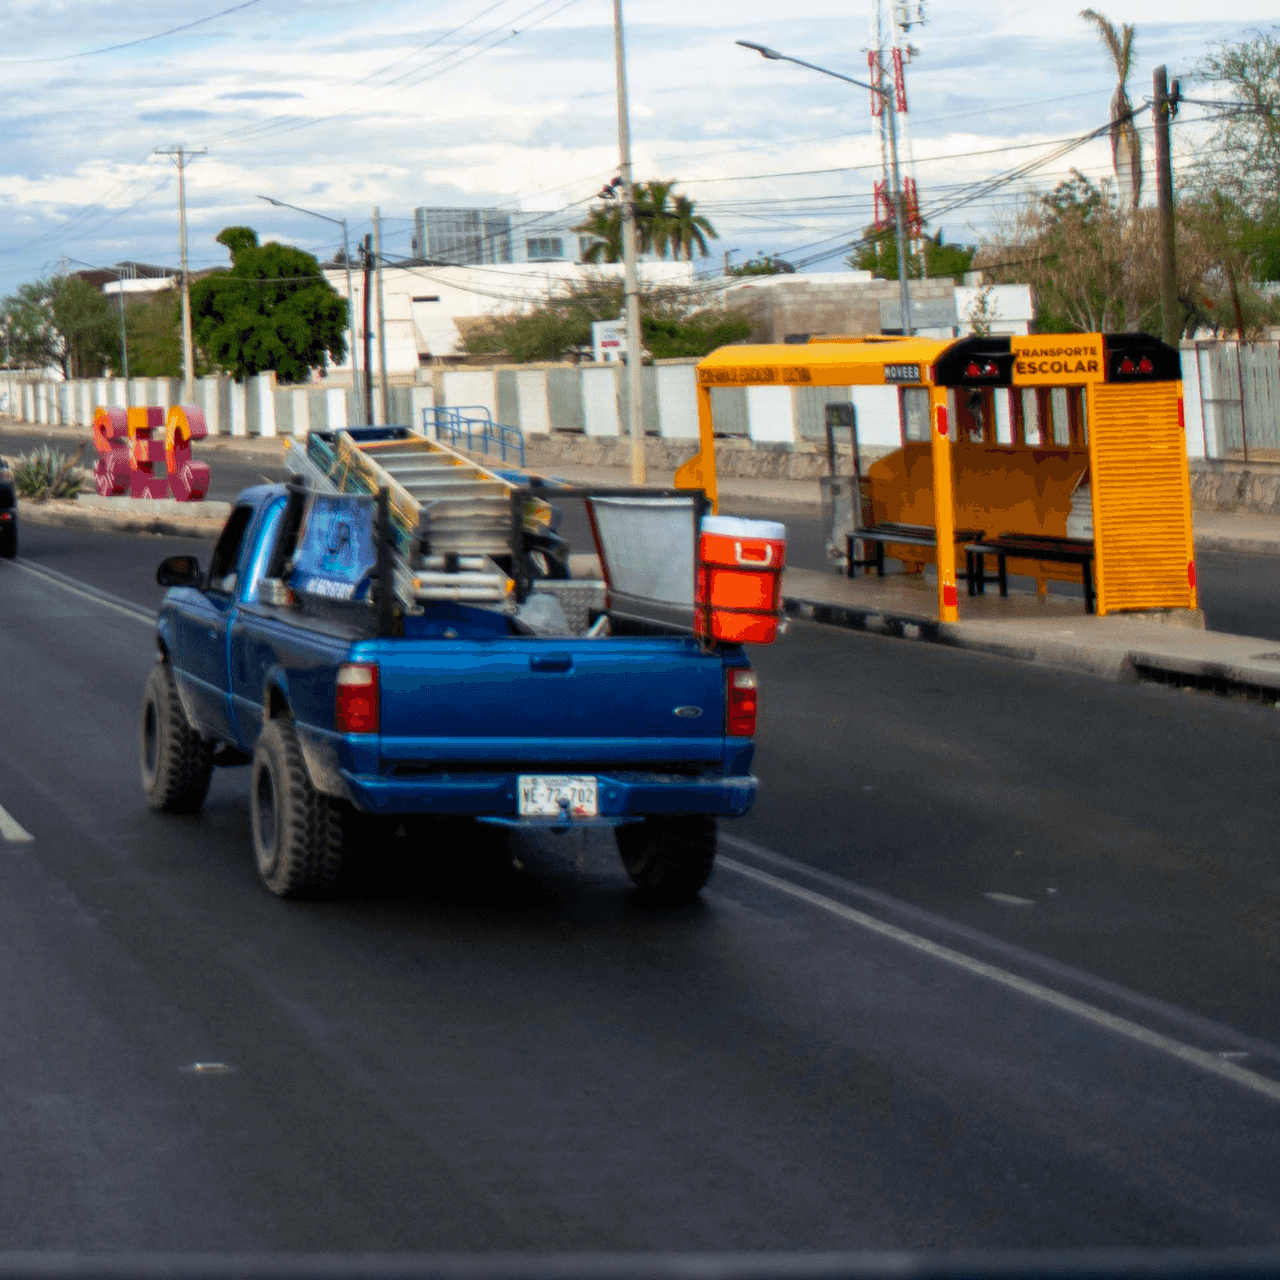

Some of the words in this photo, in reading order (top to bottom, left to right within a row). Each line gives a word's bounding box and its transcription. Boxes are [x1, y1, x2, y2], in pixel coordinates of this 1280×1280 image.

[1014, 346, 1098, 357] TRANSPORTE
[1015, 360, 1099, 375] ESCOLAR
[93, 405, 211, 501] SEC
